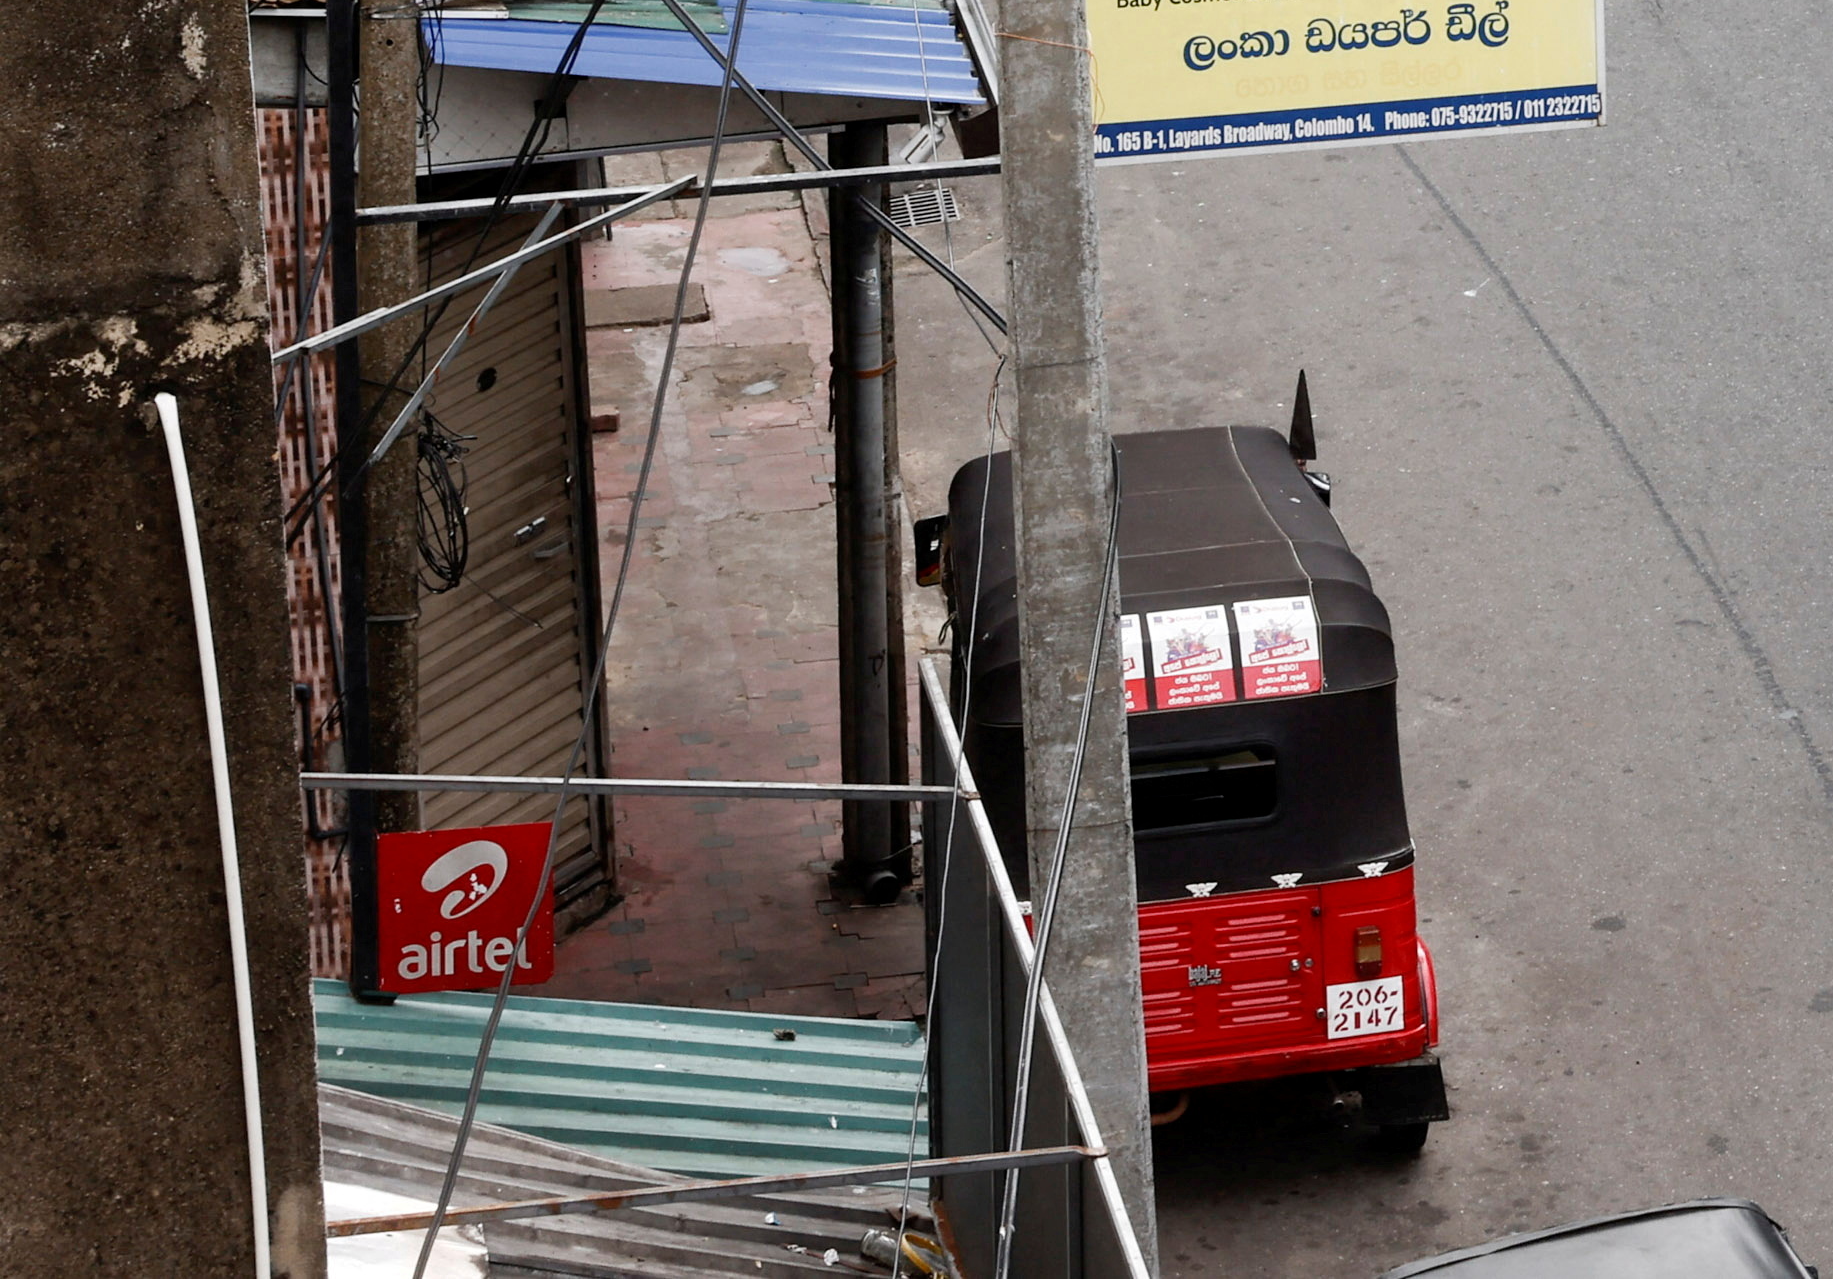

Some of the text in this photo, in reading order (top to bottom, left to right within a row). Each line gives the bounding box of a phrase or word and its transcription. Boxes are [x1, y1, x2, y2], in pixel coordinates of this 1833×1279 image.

[1183, 29, 1291, 71] ලංකා
[1093, 94, 1600, 154] No. 165 B-1, Layards Broadway, Colombo 14. Phone: 075-9322715 / 011 2322715
[397, 926, 532, 980] airtel
[1339, 985, 1399, 1010] 206-
[1334, 1006, 1398, 1032] 2147
